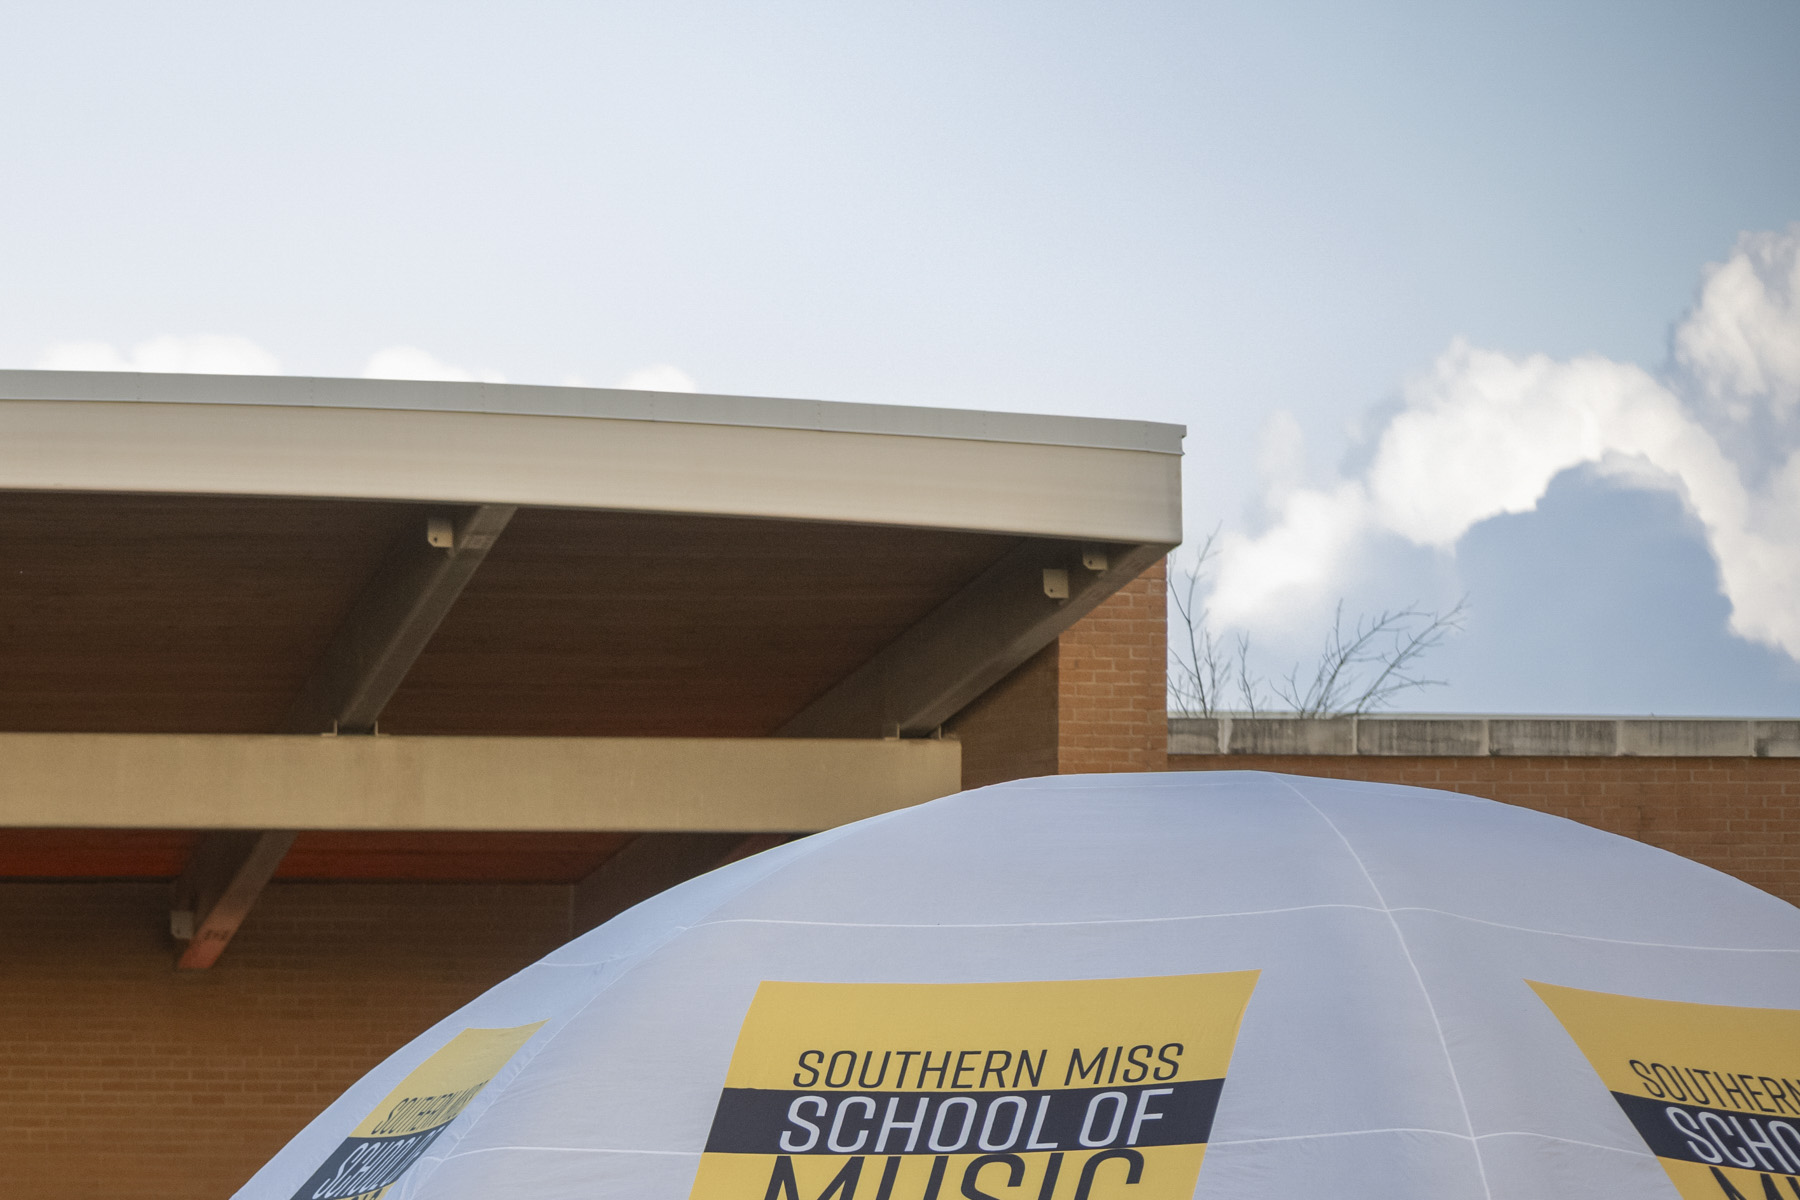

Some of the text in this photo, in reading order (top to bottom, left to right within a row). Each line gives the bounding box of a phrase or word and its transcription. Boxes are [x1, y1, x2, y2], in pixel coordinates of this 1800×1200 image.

[793, 1042, 1185, 1089] SOUTHERN MISS
[779, 1088, 1174, 1153] SCHOOL OF
